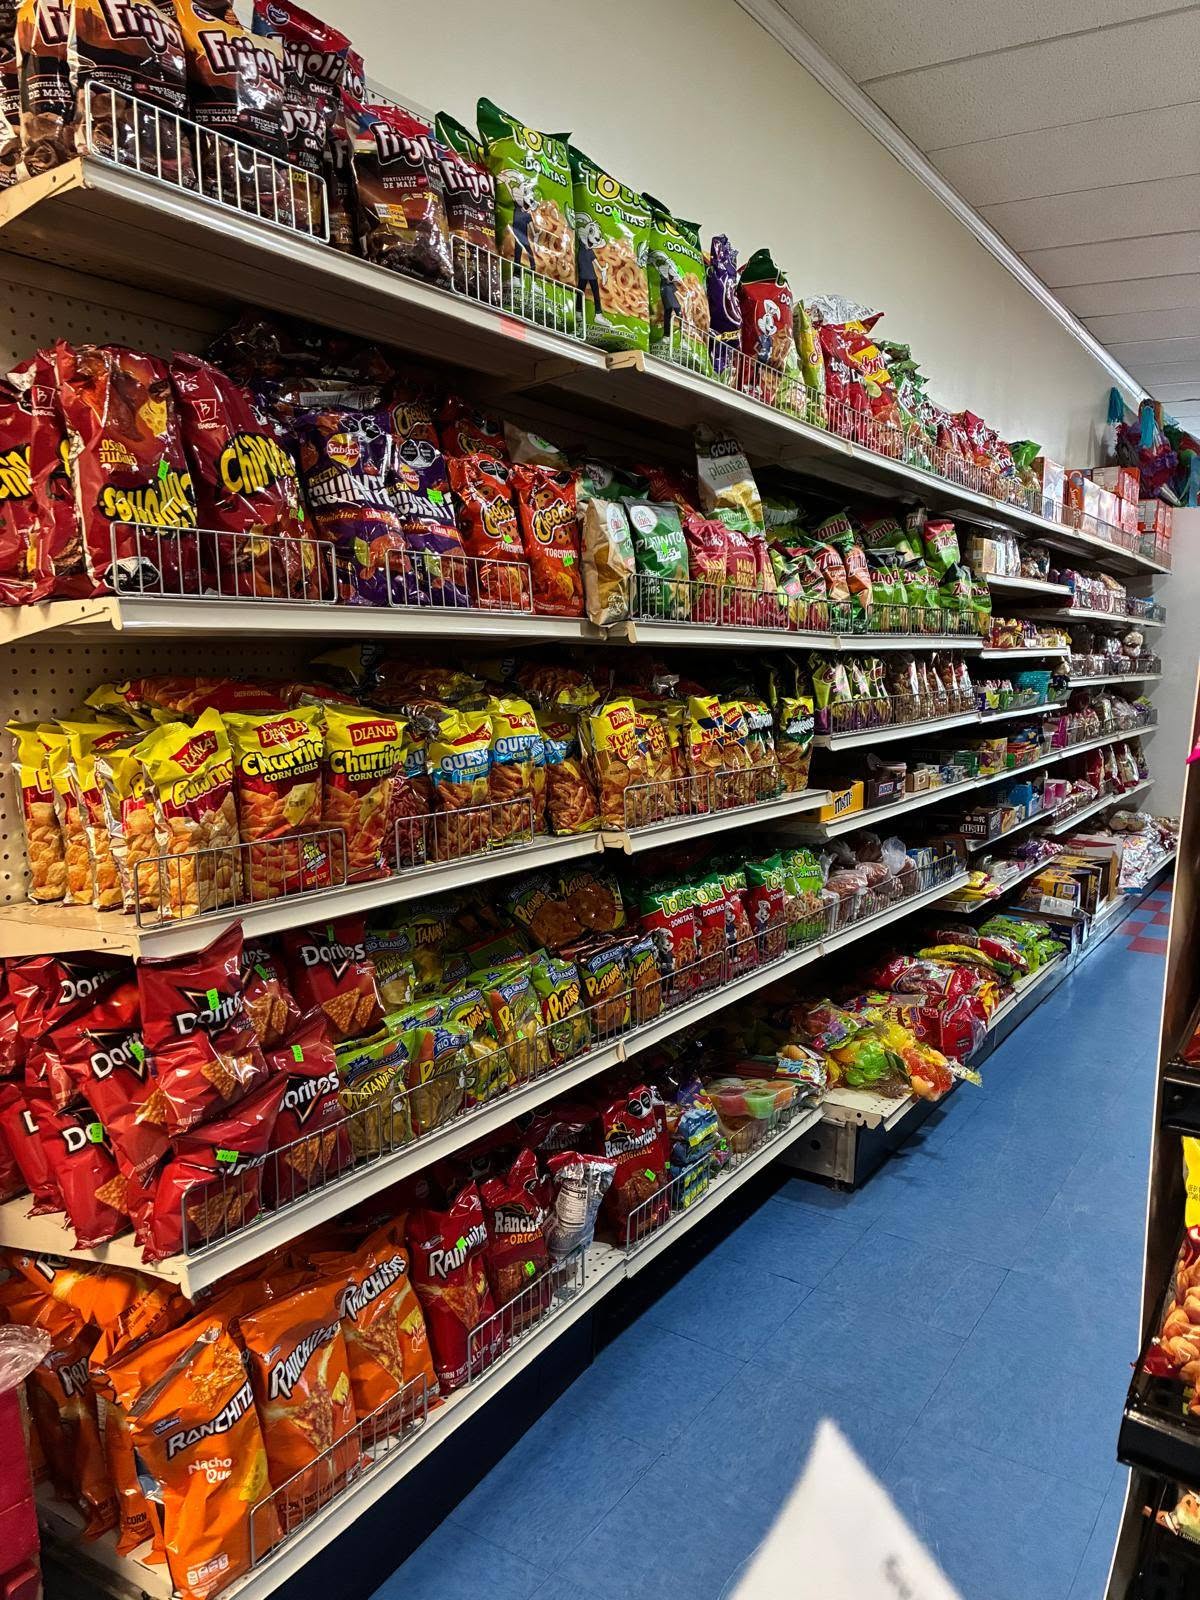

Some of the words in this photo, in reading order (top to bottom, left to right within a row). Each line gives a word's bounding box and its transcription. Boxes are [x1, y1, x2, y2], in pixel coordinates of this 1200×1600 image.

[28, 89, 40, 100] DE
[711, 440, 739, 457] GOYA
[352, 725, 394, 742] DIANA
[263, 769, 293, 783] CORN
[293, 760, 319, 776] CURLS
[348, 771, 373, 782] CORN
[702, 904, 725, 918] DONITAS
[301, 942, 366, 967] Doritos
[604, 1125, 657, 1159] Rancheritos
[187, 1456, 233, 1476] Nacho
[126, 1512, 147, 1525] CORN
